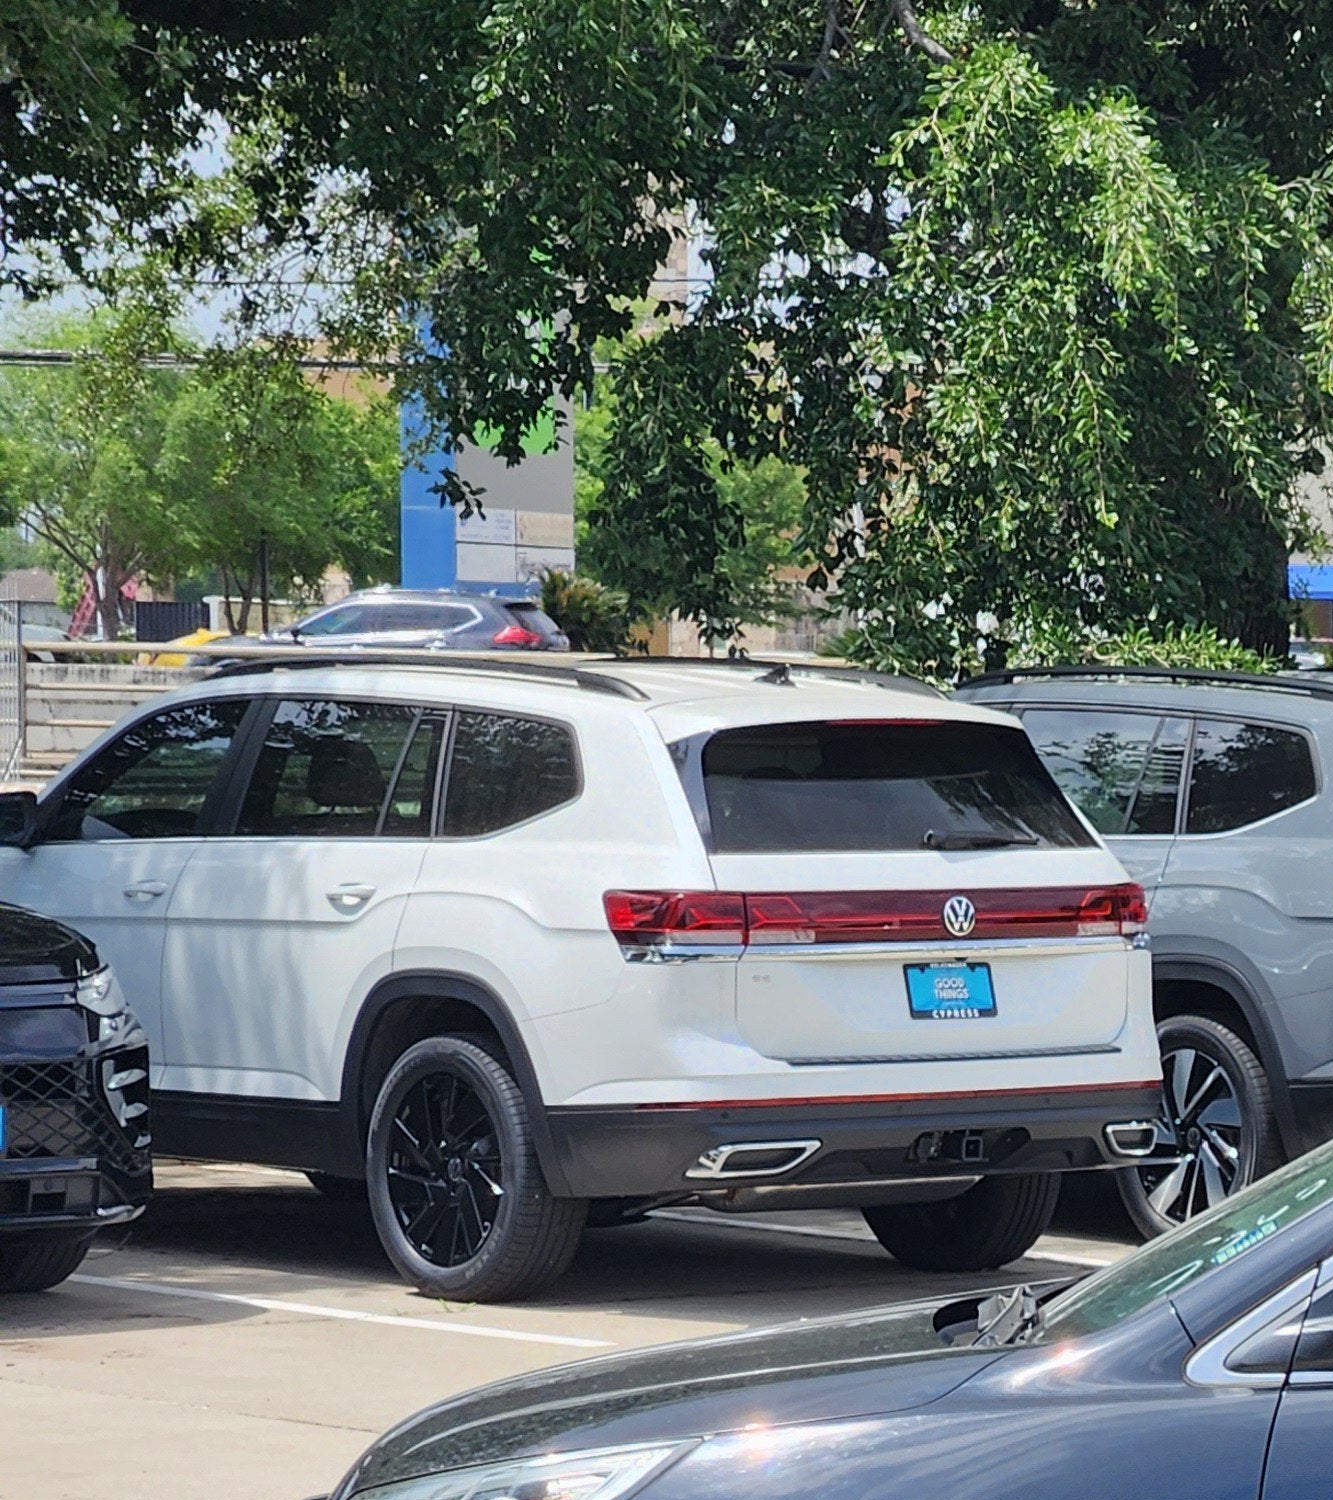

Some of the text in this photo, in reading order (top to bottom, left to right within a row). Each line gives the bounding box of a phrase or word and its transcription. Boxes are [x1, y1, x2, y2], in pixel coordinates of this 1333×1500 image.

[934, 977, 966, 988] GOOD
[934, 988, 970, 999] THINGS
[932, 1008, 979, 1018] CYPRESS
